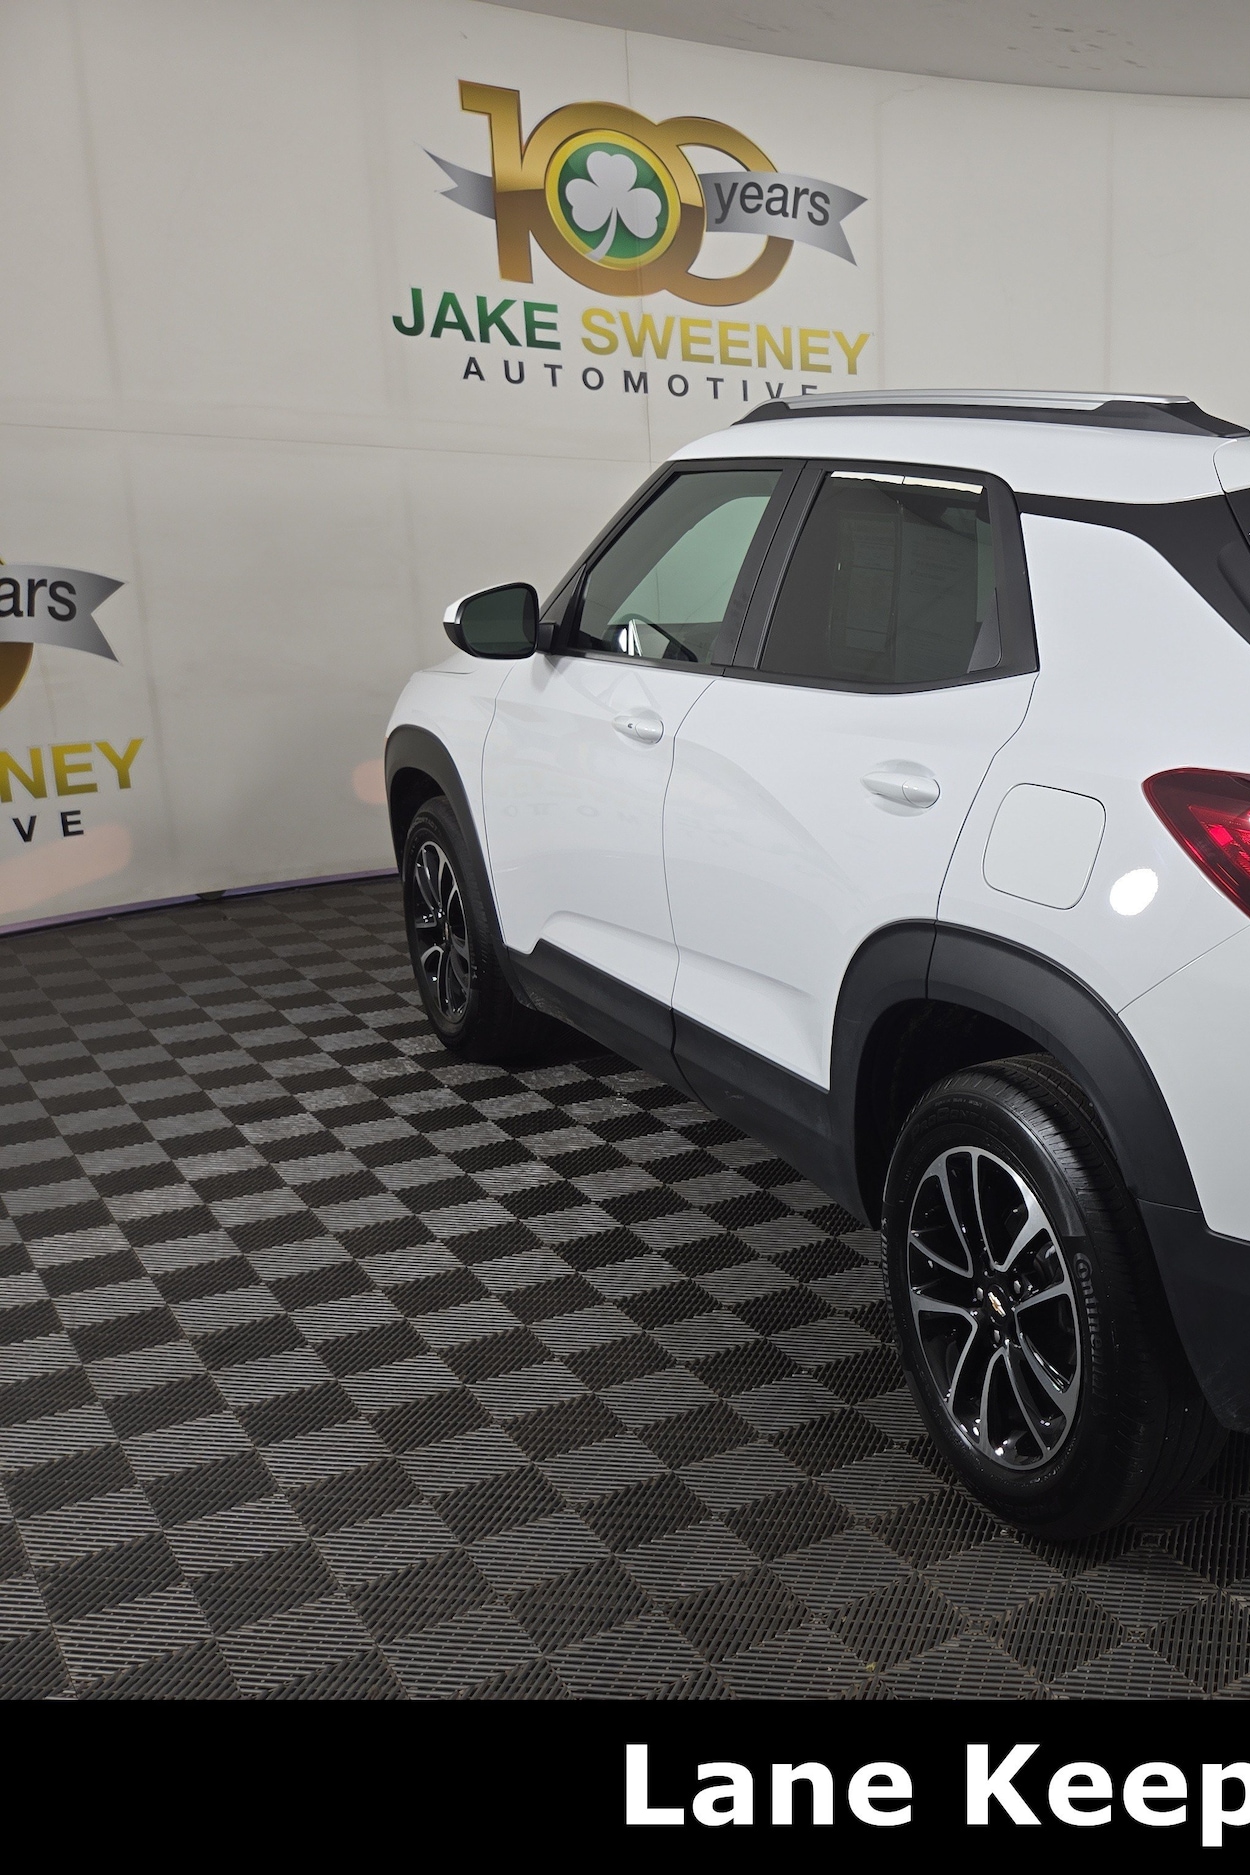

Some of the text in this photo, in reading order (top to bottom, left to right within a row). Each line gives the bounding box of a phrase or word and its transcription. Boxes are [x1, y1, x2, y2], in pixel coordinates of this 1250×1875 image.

[713, 180, 831, 226] years
[392, 287, 870, 375] JAKE SWEENEY
